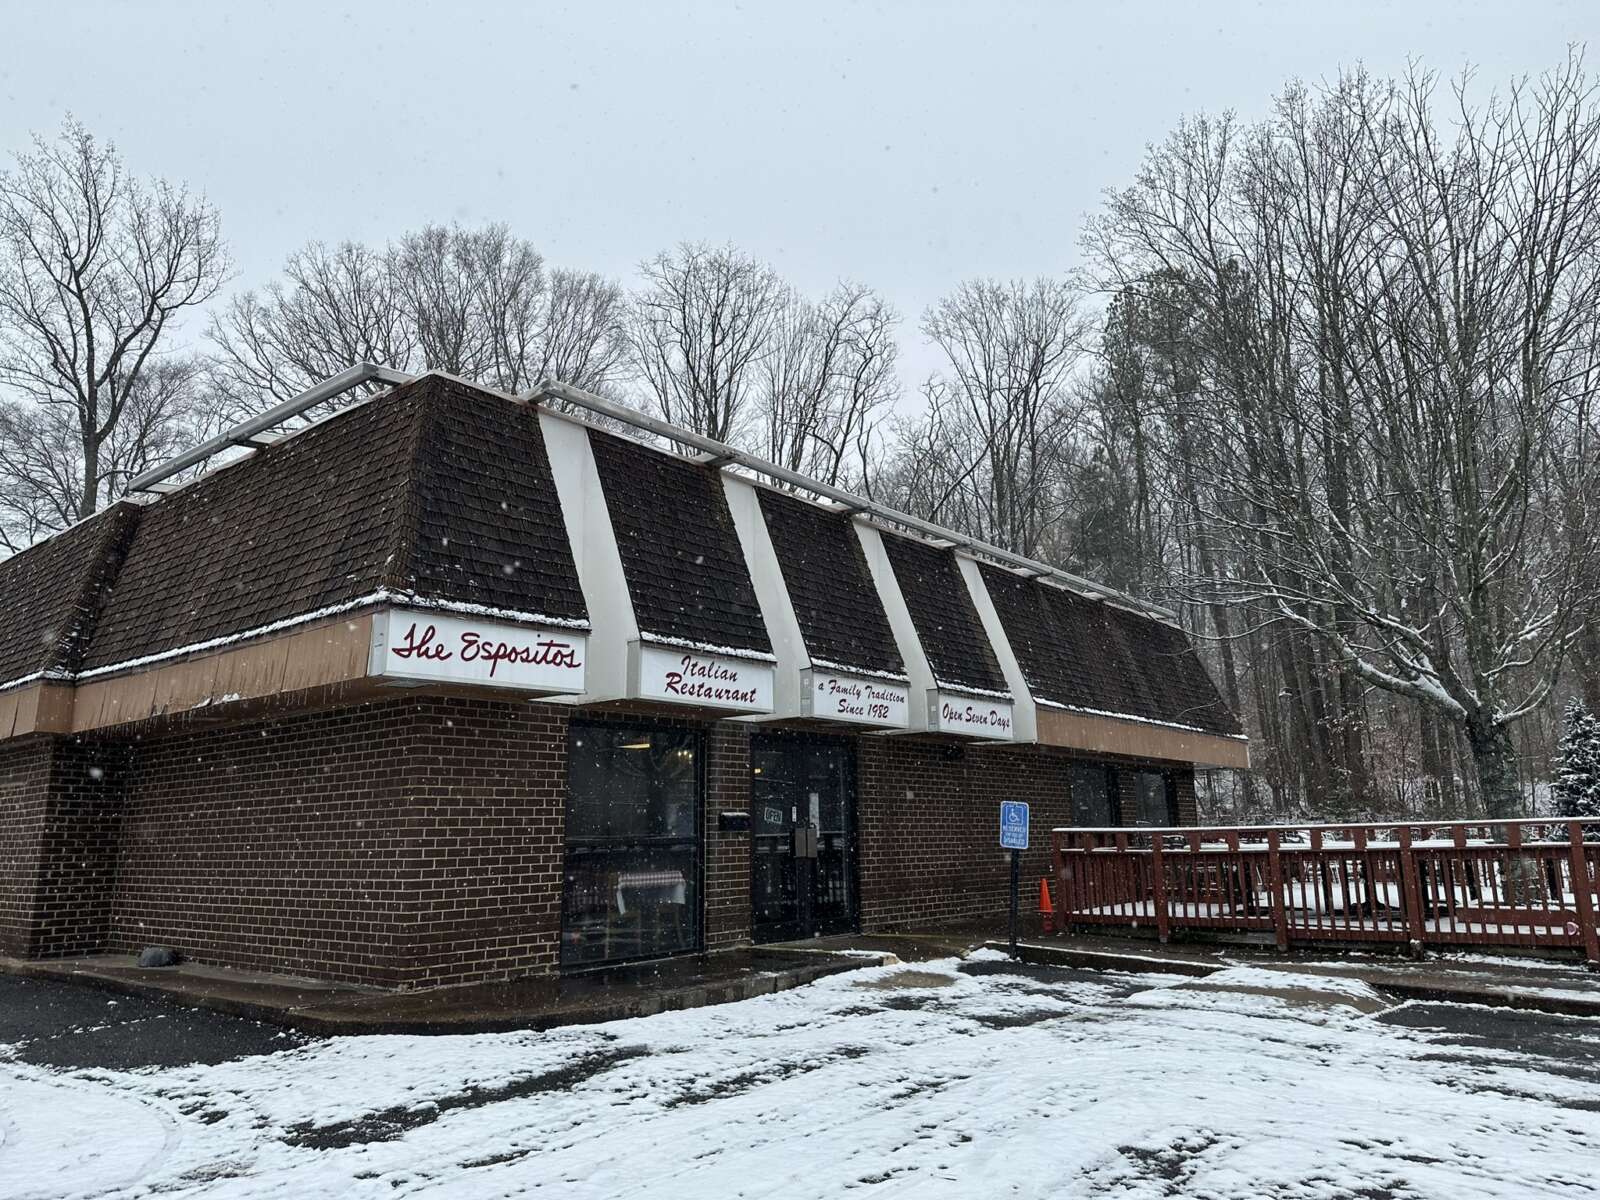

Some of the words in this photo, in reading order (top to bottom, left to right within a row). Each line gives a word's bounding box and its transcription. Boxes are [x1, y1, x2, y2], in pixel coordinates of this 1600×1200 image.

[392, 623, 452, 660] The
[461, 632, 581, 677] Espositos
[681, 655, 737, 682] Italian
[664, 672, 756, 703] Restaurant
[818, 682, 824, 691] a
[828, 680, 861, 700] Family
[865, 685, 905, 703] Tradition
[838, 699, 864, 715] Since
[867, 704, 889, 719] 1982
[942, 703, 963, 724] Open
[965, 706, 988, 725] Seven
[990, 710, 1010, 732] Days
